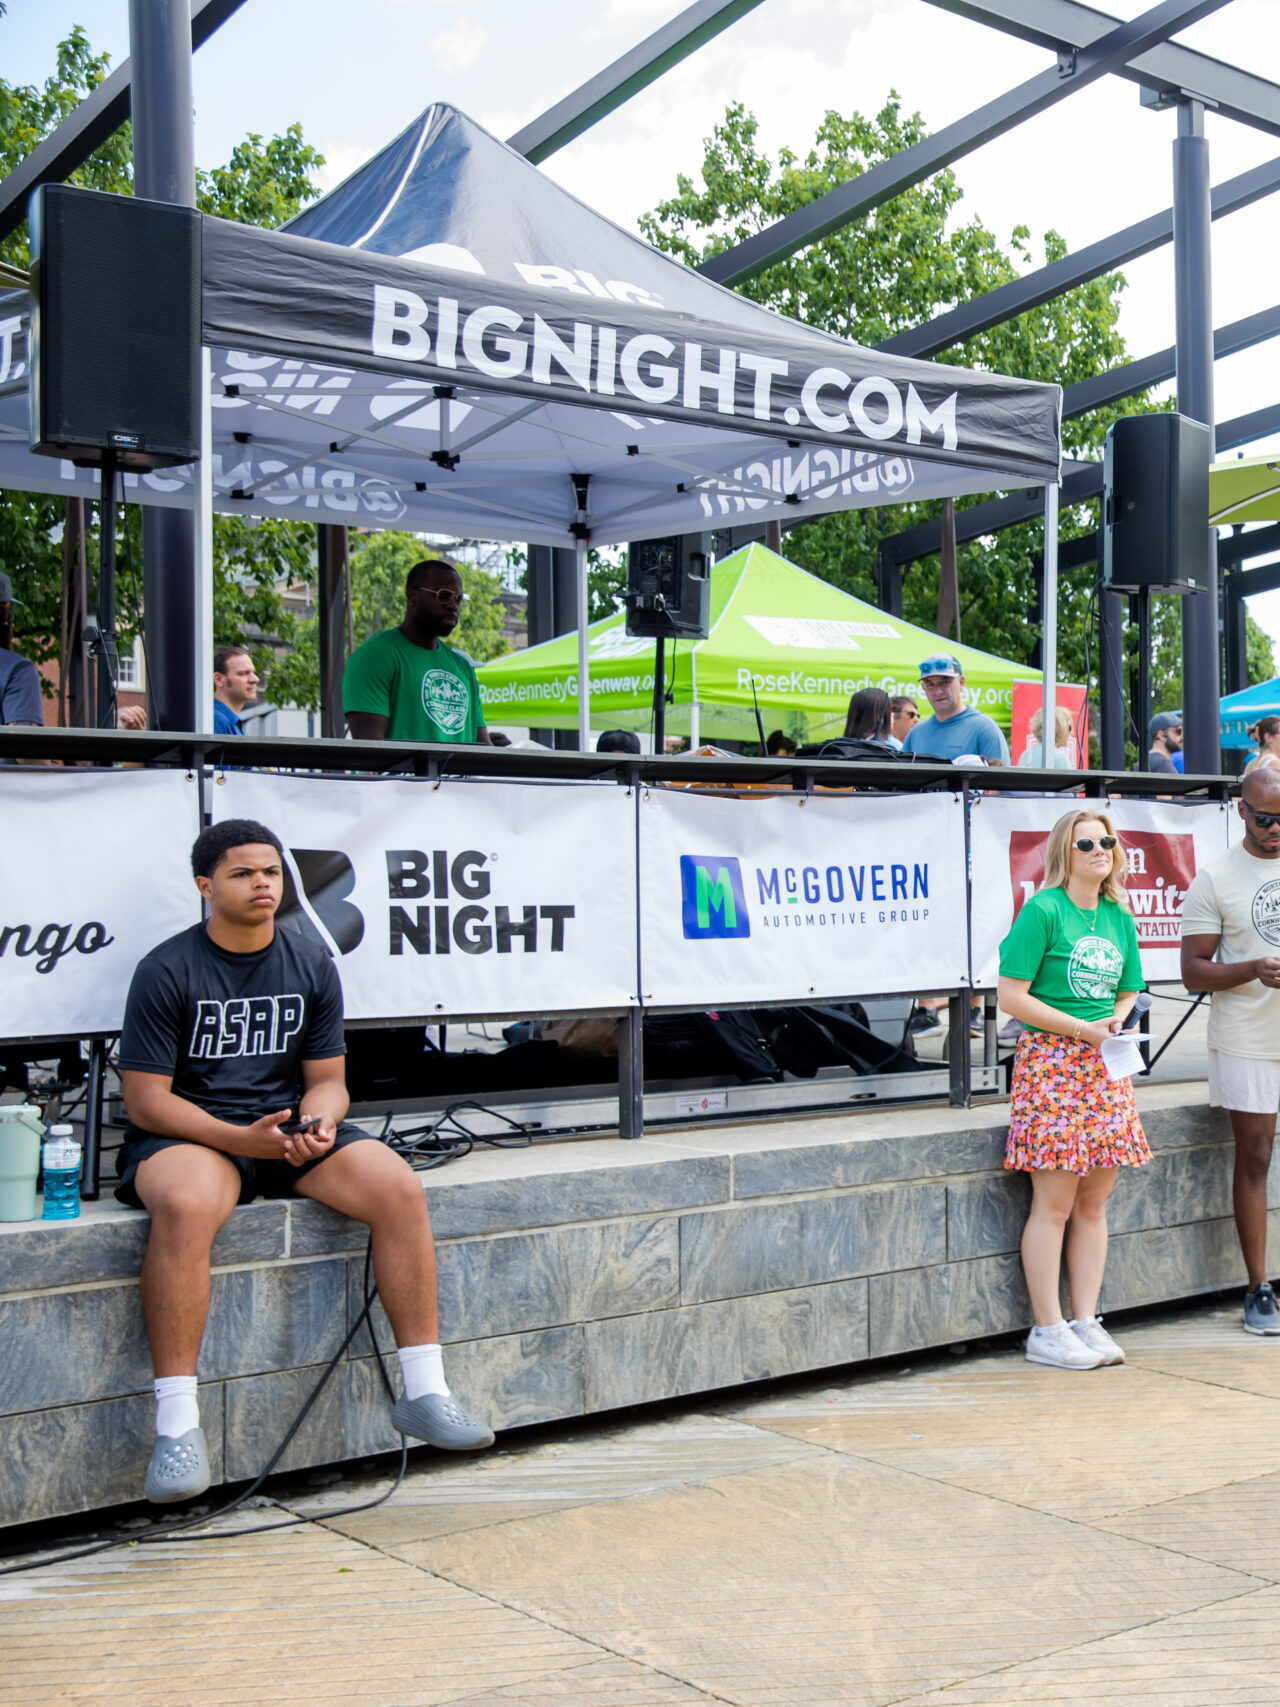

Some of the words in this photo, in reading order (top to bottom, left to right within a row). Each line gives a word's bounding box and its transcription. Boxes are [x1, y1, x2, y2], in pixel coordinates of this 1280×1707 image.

[372, 284, 958, 452] BIGNIGHT.COM
[385, 849, 491, 900] BIG
[388, 904, 576, 956] NIGHT
[763, 911, 867, 928] AUTOMOTIVE
[878, 908, 930, 924] GROUP
[0, 921, 115, 975] ngo
[188, 993, 305, 1059] ASAP
